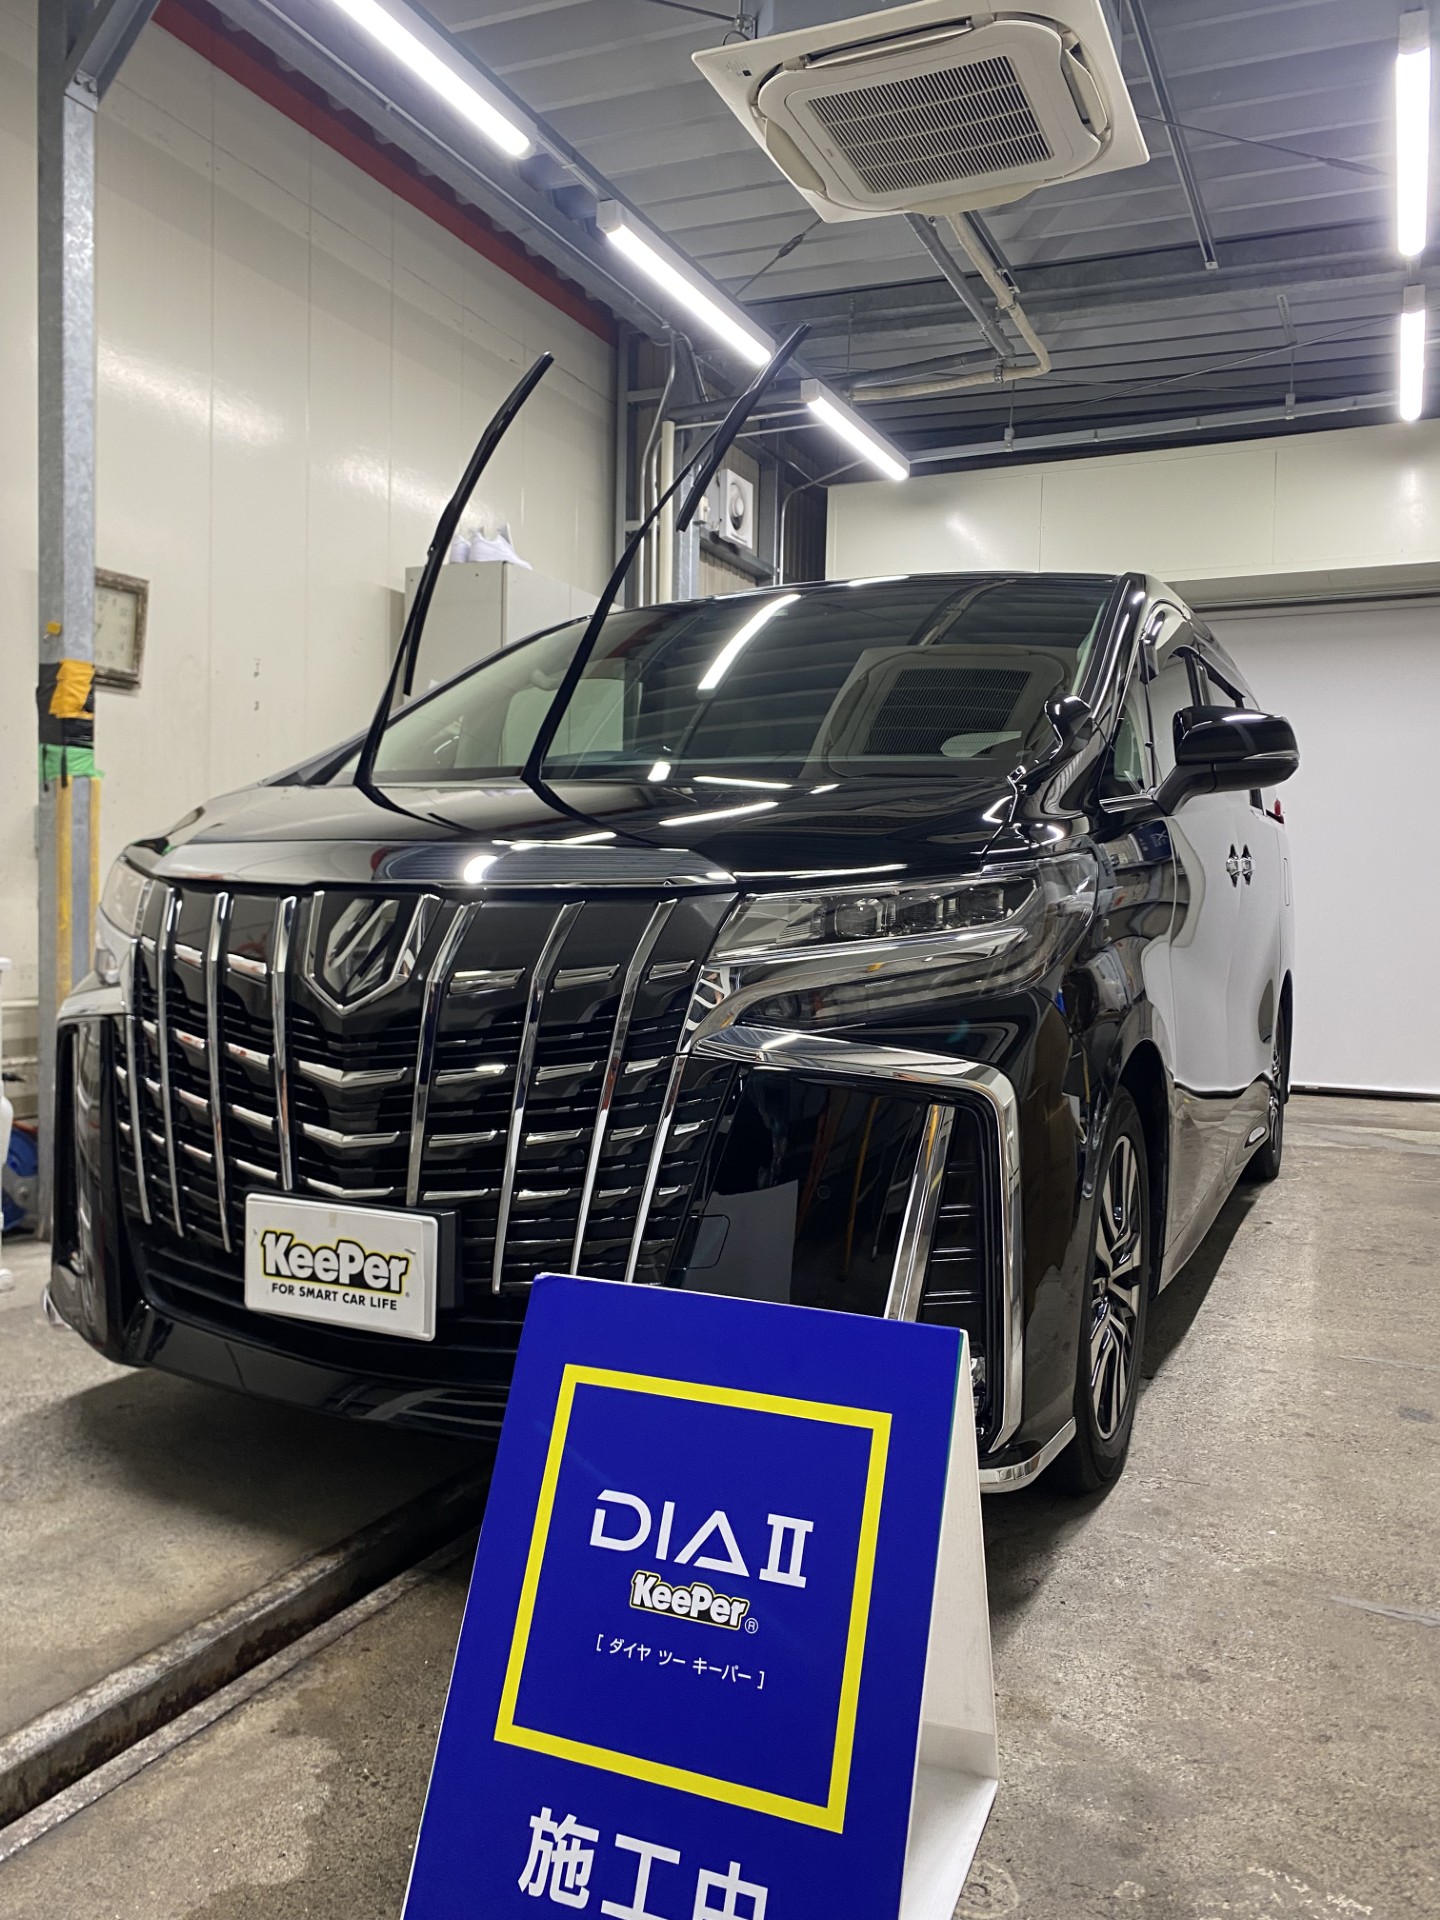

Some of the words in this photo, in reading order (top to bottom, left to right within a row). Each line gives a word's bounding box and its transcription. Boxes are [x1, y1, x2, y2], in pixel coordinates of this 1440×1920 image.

[271, 1282, 295, 1296] FOR
[299, 1286, 338, 1302] SMART
[342, 1292, 366, 1306] CAR
[370, 1296, 397, 1311] LIFE
[589, 1489, 750, 1577] DIA
[609, 1637, 651, 1661] ダイヤ
[692, 1657, 751, 1682] キーパー
[517, 1806, 769, 1920] 施工中
